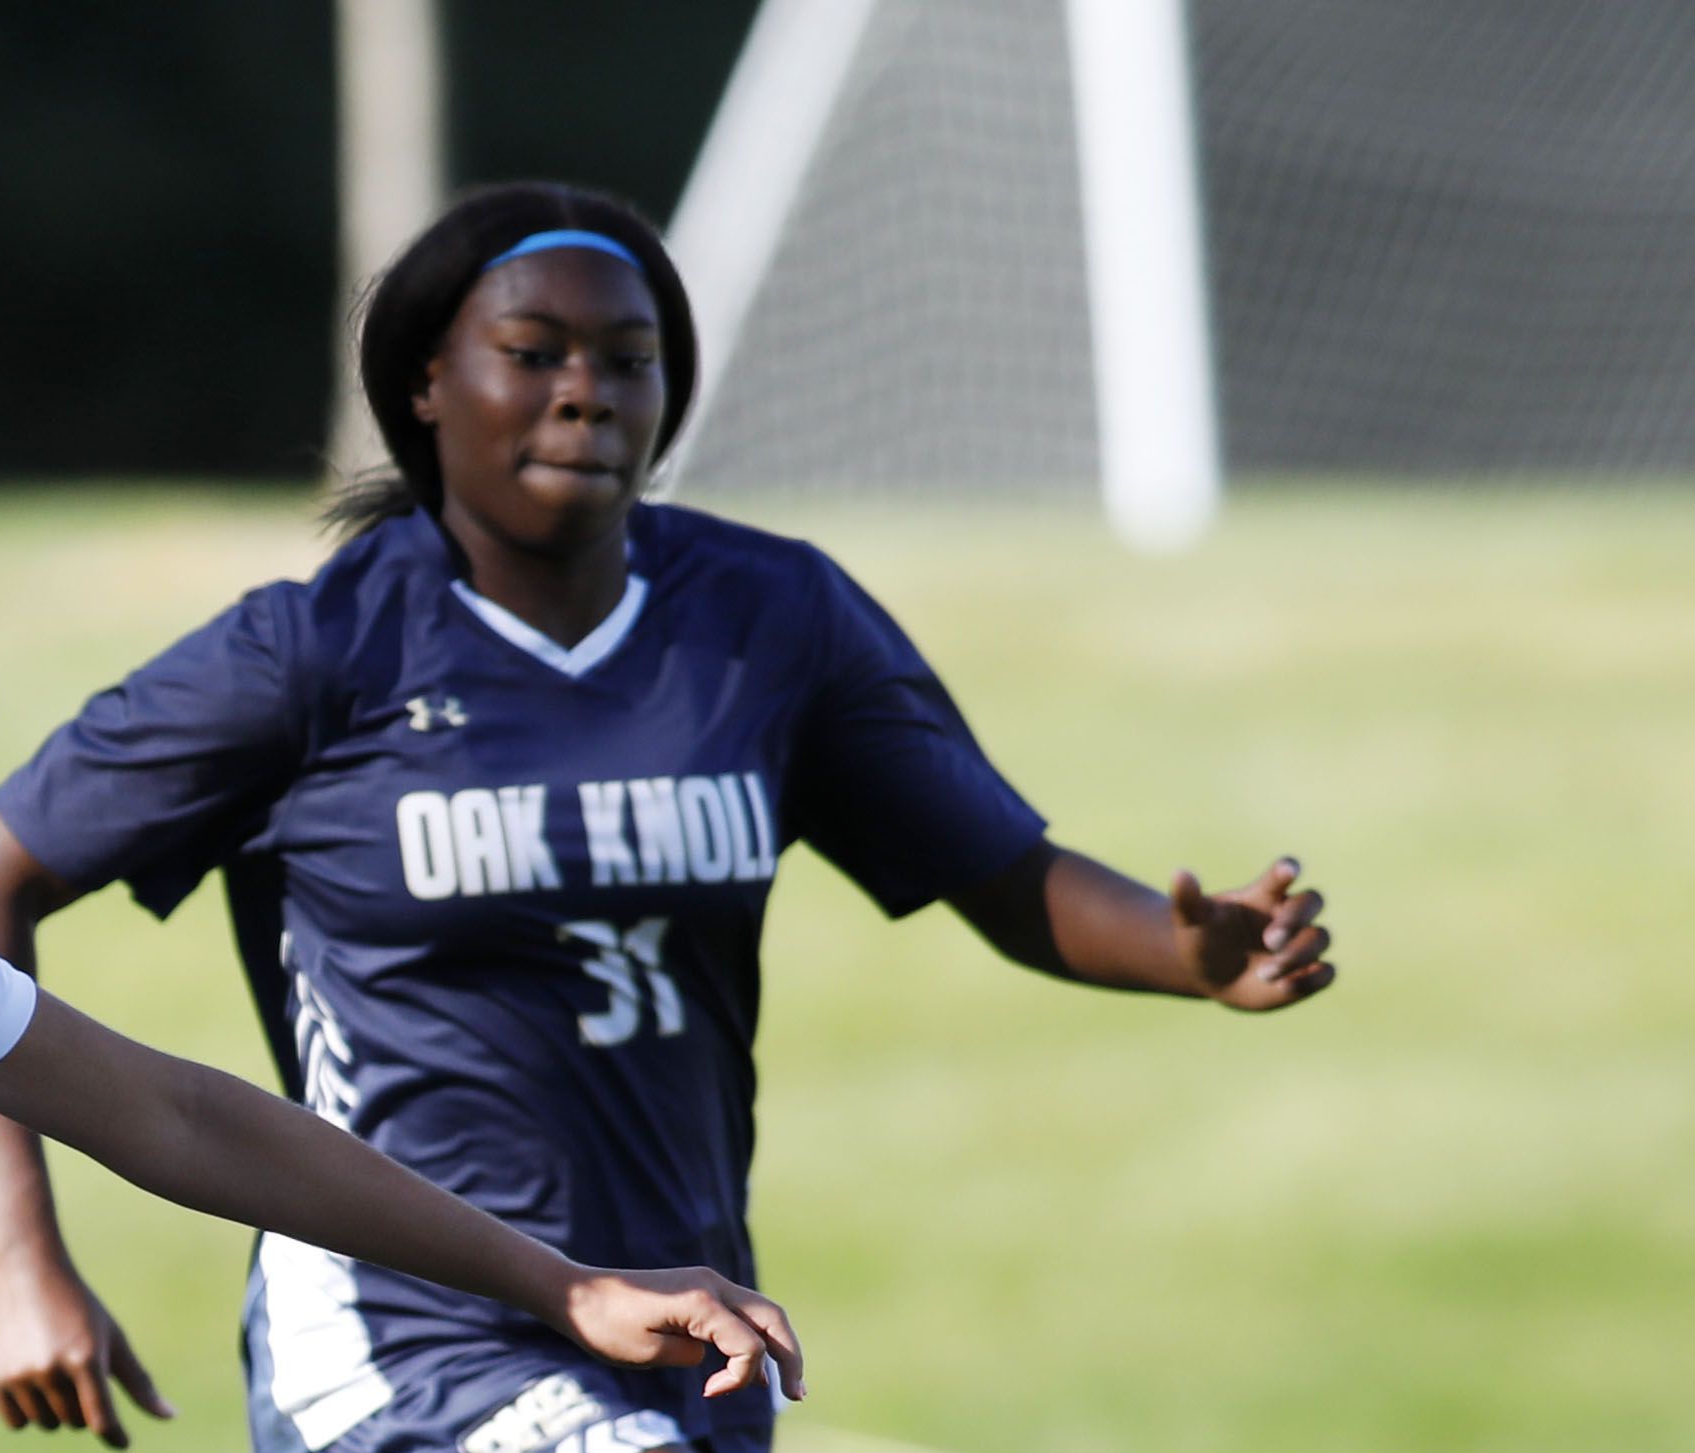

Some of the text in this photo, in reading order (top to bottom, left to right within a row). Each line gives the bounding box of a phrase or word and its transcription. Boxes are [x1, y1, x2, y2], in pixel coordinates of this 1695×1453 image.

[396, 771, 778, 899] OAK KNOLL
[556, 917, 686, 1047] 31
